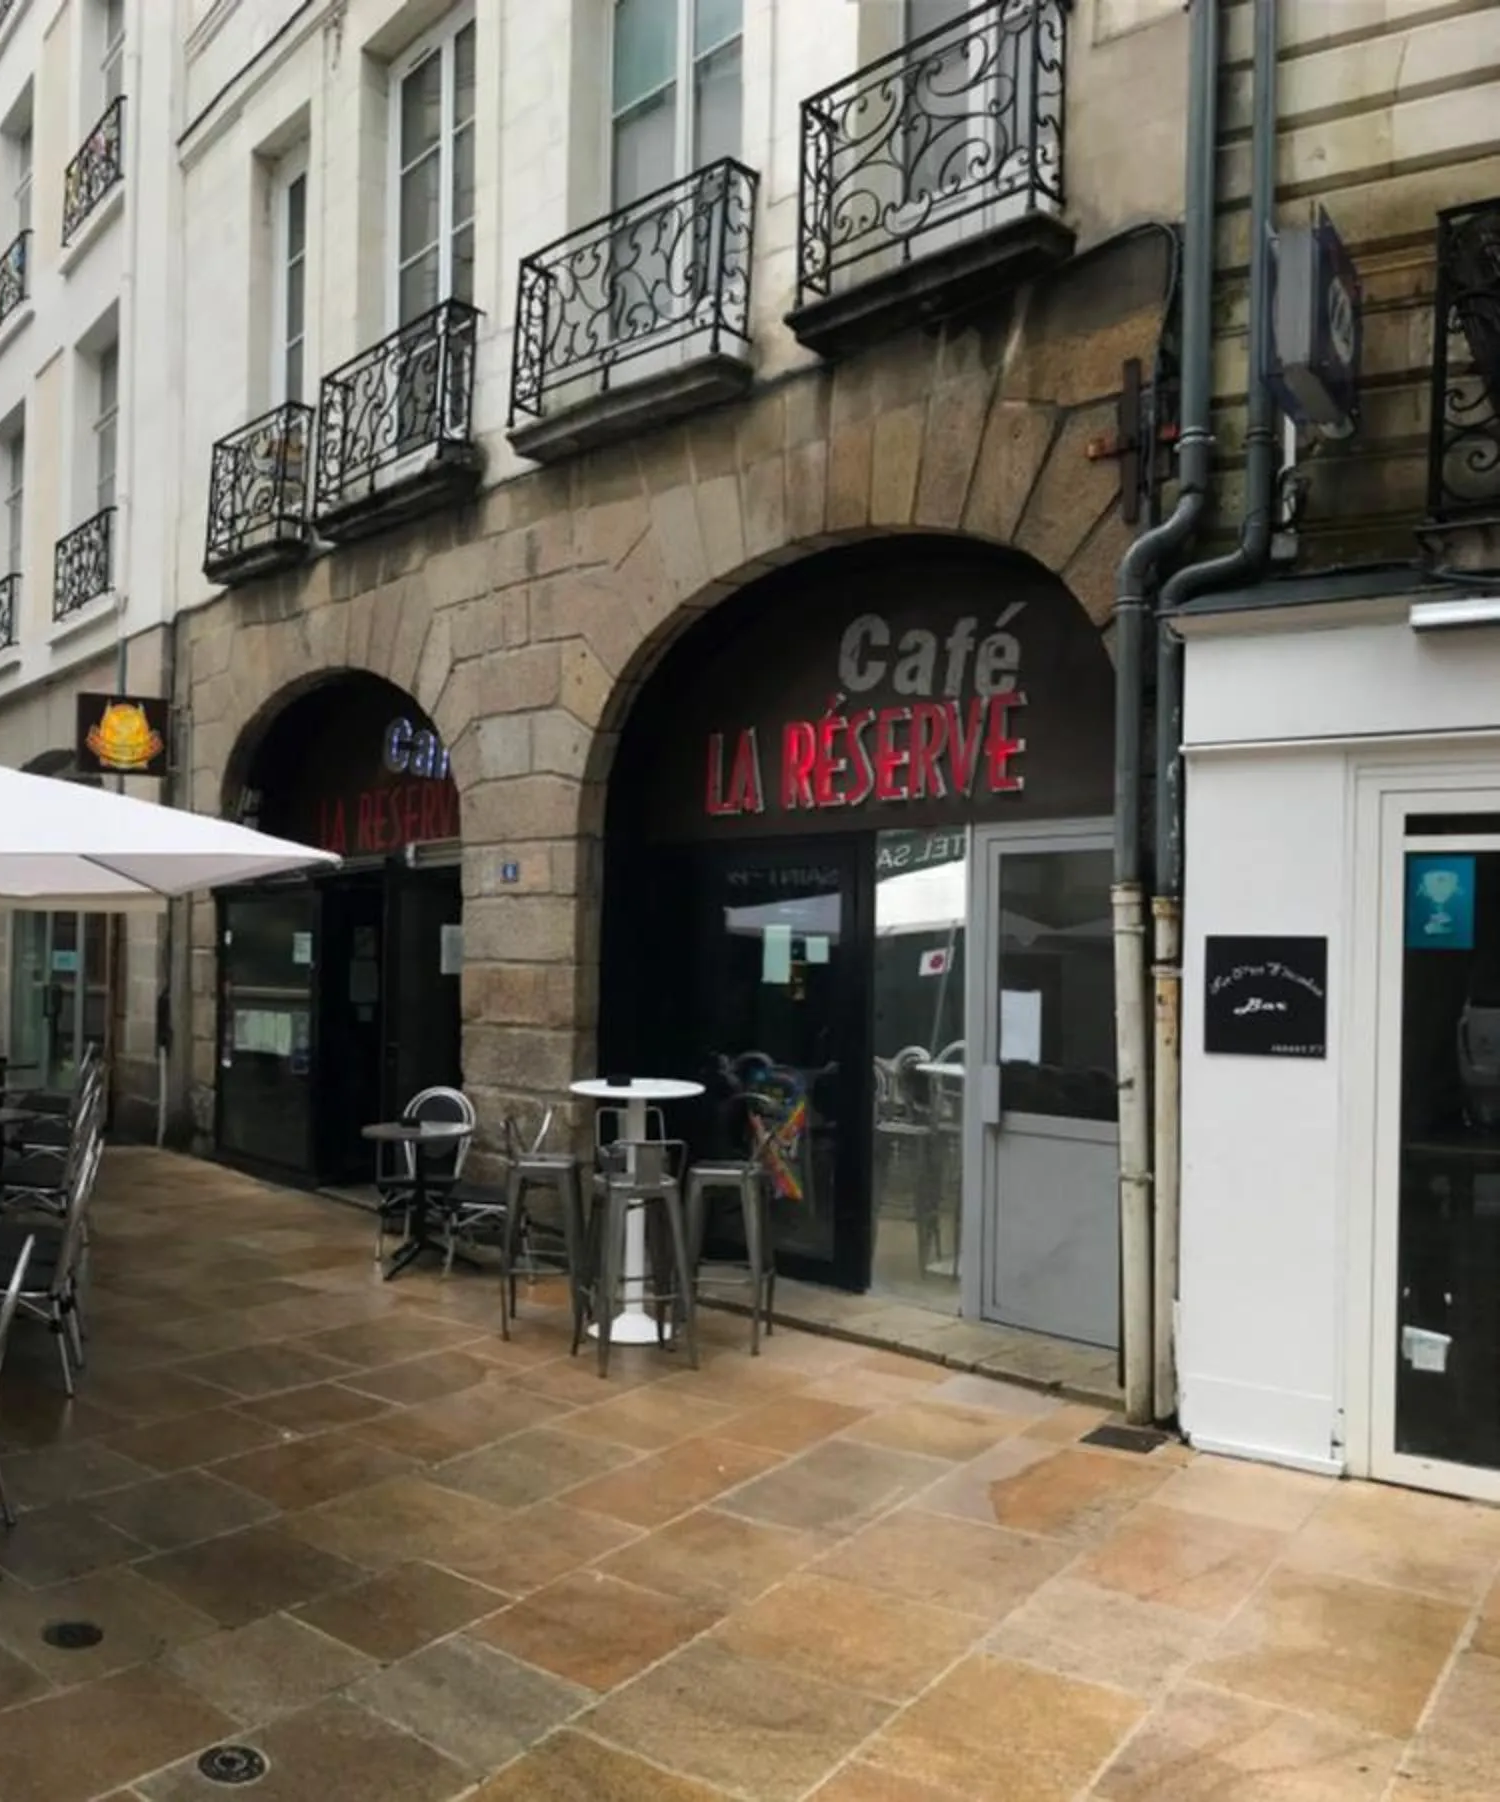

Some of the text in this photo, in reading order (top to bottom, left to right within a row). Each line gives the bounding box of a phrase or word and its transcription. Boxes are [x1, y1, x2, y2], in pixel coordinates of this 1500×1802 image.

[837, 601, 1027, 697] Café
[706, 691, 1028, 815] LA RÉSERVE
